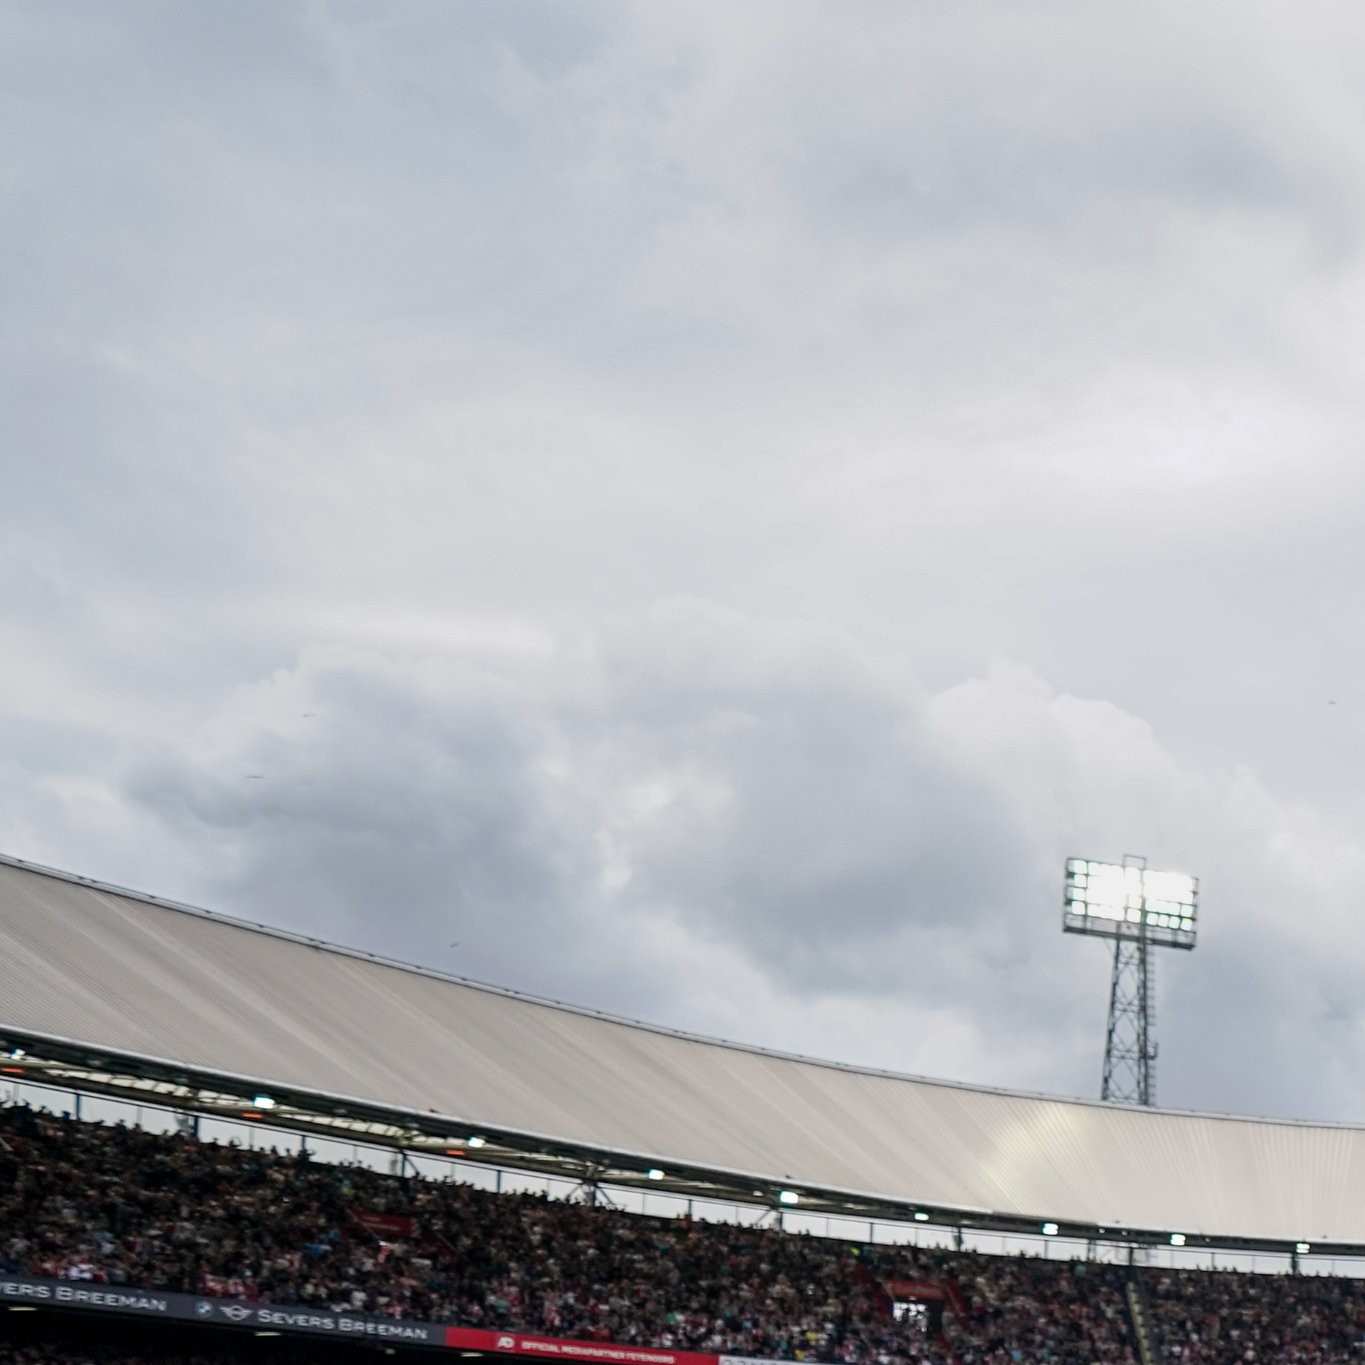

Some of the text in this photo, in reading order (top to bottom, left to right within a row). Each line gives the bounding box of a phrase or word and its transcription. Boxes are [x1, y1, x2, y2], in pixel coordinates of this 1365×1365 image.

[55, 1286, 168, 1312] BREEMAN
[257, 1308, 428, 1339] SEVERS BREEMAN
